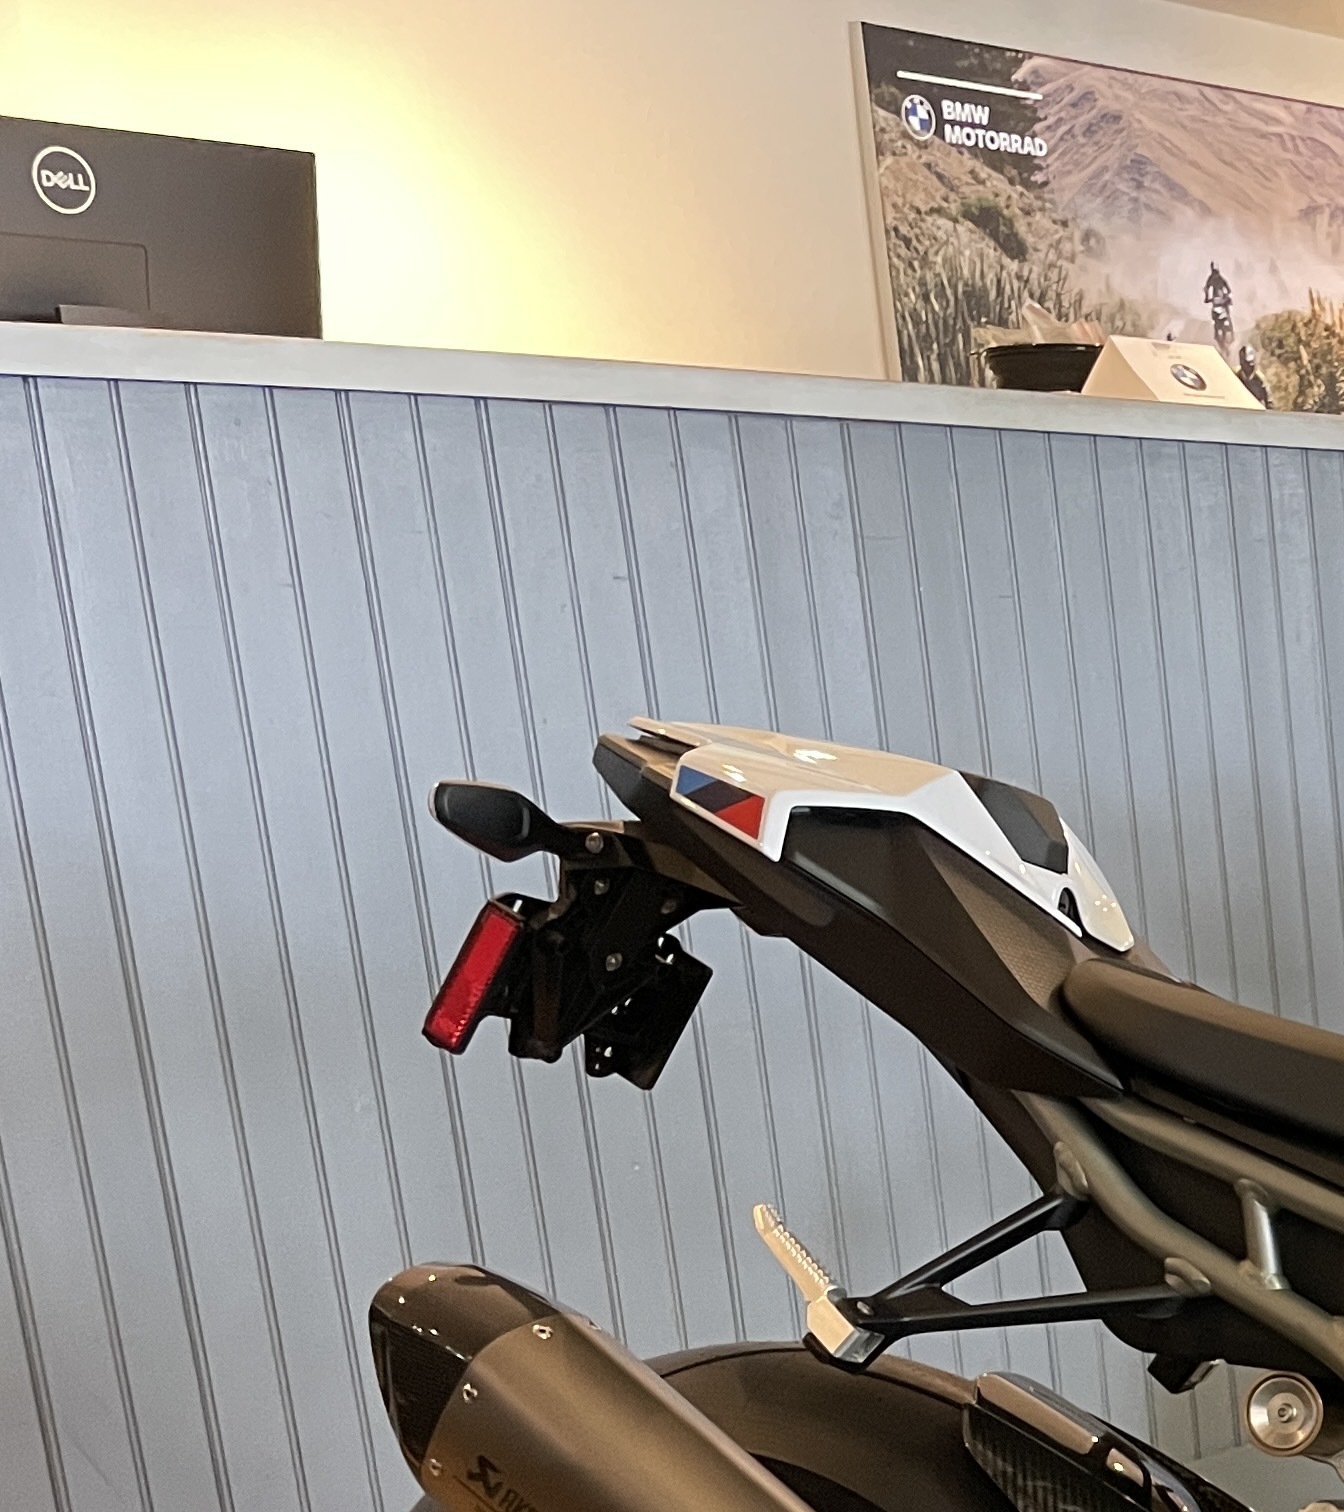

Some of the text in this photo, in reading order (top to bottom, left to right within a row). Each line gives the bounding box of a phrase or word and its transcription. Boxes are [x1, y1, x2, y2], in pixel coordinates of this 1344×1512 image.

[940, 99, 991, 126] BMW
[943, 123, 1048, 157] MOTORRAD
[41, 169, 90, 191] DELL
